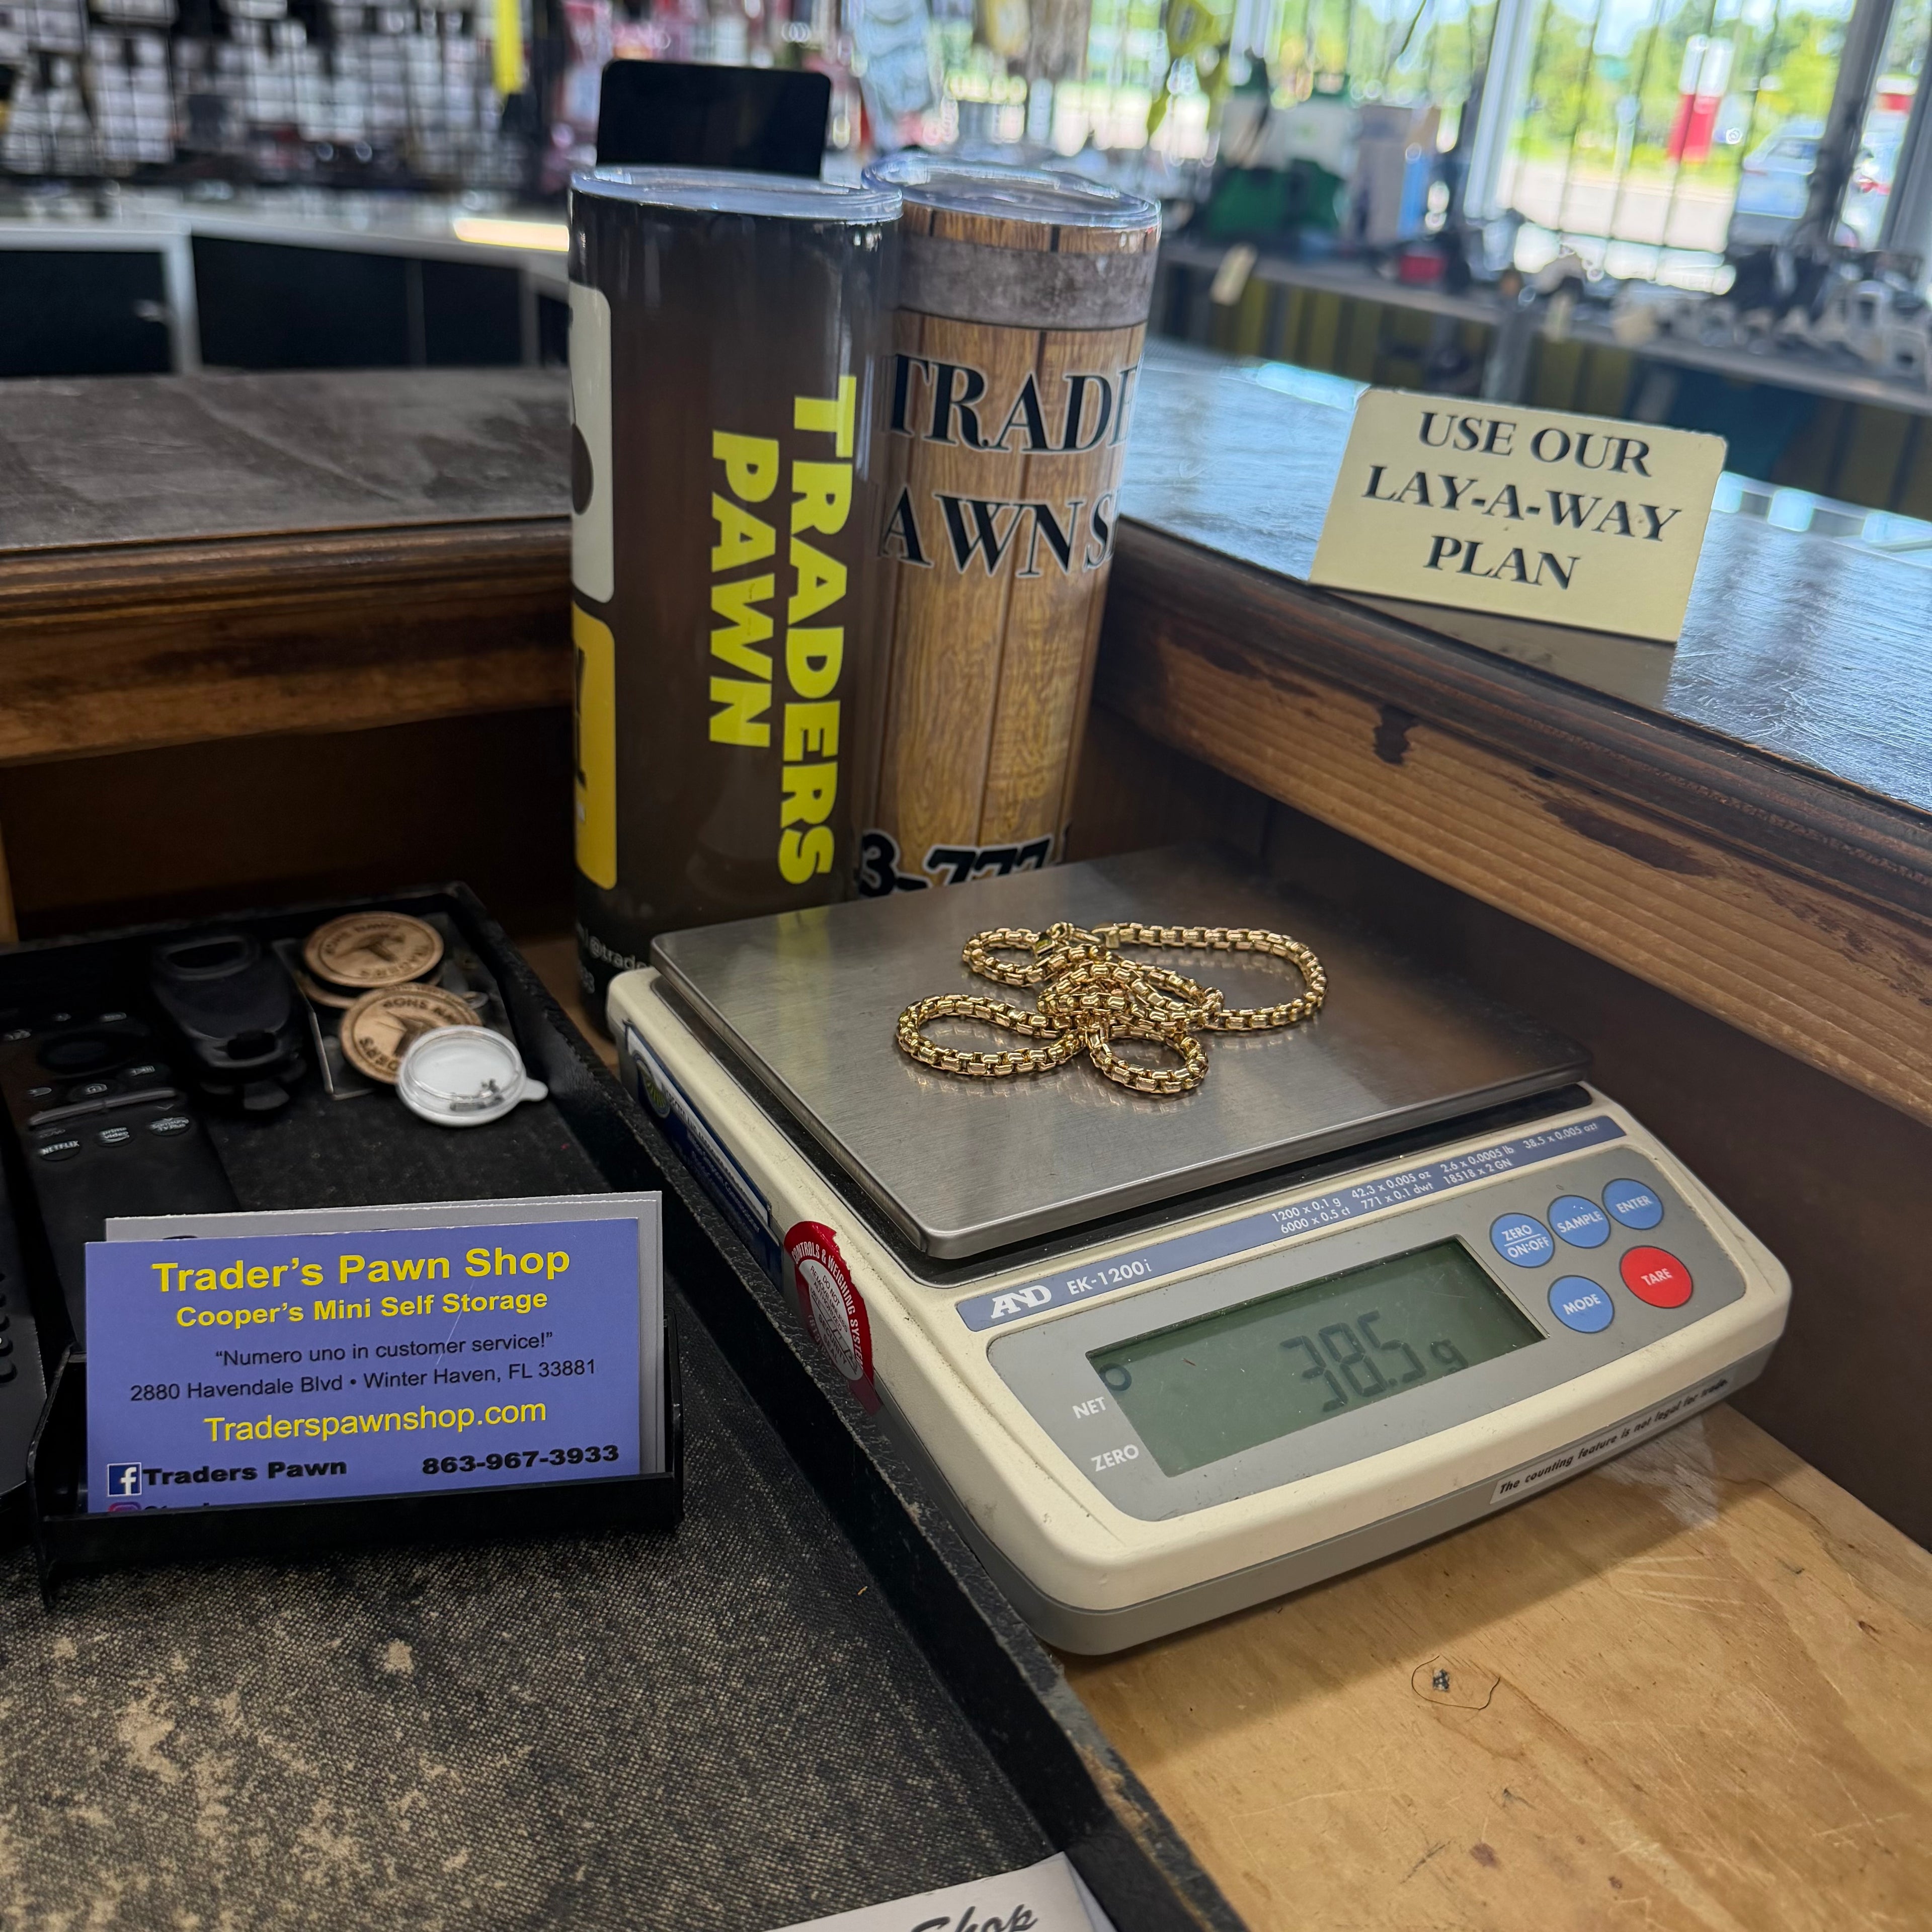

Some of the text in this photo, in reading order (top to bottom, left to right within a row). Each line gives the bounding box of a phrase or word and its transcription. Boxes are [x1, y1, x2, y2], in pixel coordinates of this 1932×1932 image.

[1418, 411, 1652, 477] USE OUR
[1361, 464, 1682, 542] LAY-A-WAY
[1422, 534, 1581, 591] PLAN
[709, 430, 779, 748] PAWN
[778, 375, 856, 884] TRADERS
[39, 1140, 80, 1156] NETFLIX
[1522, 1137, 1546, 1150] 38.5
[1554, 1125, 1582, 1140] 0.005
[1439, 1161, 1458, 1173] 2.6
[1467, 1149, 1502, 1165] 0.0005
[1502, 1146, 1514, 1155] lb
[1442, 1158, 1514, 1185] 18518 x 2 GN
[1351, 1170, 1432, 1199] 42.3 x 0.005 oz
[1360, 1182, 1434, 1210] 771 x 0.1 dwt
[1271, 1197, 1342, 1223] 1200 x 0.1 g
[1616, 1195, 1653, 1214] ENTER
[1280, 1206, 1351, 1234] 6000 x 0.5 ct
[1501, 1224, 1533, 1242] ZERO
[1556, 1211, 1604, 1234] SAMPLE
[151, 1244, 571, 1293] Trader’s Pawn Shop
[791, 1241, 821, 1264] CONTROLS
[821, 1248, 827, 1265] &
[827, 1255, 856, 1316] WEIGHING
[810, 1265, 830, 1300] REMOVE
[1066, 1258, 1152, 1296] EK-1200i
[1640, 1267, 1673, 1286] TARE
[822, 1274, 841, 1307] DO NOT
[1563, 1293, 1602, 1315] MODE
[176, 1289, 548, 1330] Cooper’s Mini Self Storage
[309, 1347, 346, 1362] uno
[353, 1343, 369, 1359] in
[375, 1338, 466, 1358] customer
[1279, 1309, 1470, 1413] 38.5 g
[130, 1358, 597, 1402] 2880 Havendale Blvd Winter Haven, FL 33881
[203, 1401, 547, 1443] Traderspawnshop.com
[1072, 1396, 1107, 1420] NET
[422, 1444, 619, 1475] 863-967-3933
[1090, 1444, 1140, 1473] ZERO
[1499, 1480, 1520, 1495] The
[1524, 1455, 1574, 1484] counting
[1578, 1435, 1617, 1460] feature
[1621, 1427, 1630, 1438] is
[1634, 1416, 1652, 1433] not
[1653, 1400, 1682, 1422] legal
[143, 1465, 258, 1486] Traders
[268, 1461, 347, 1479] Pawn
